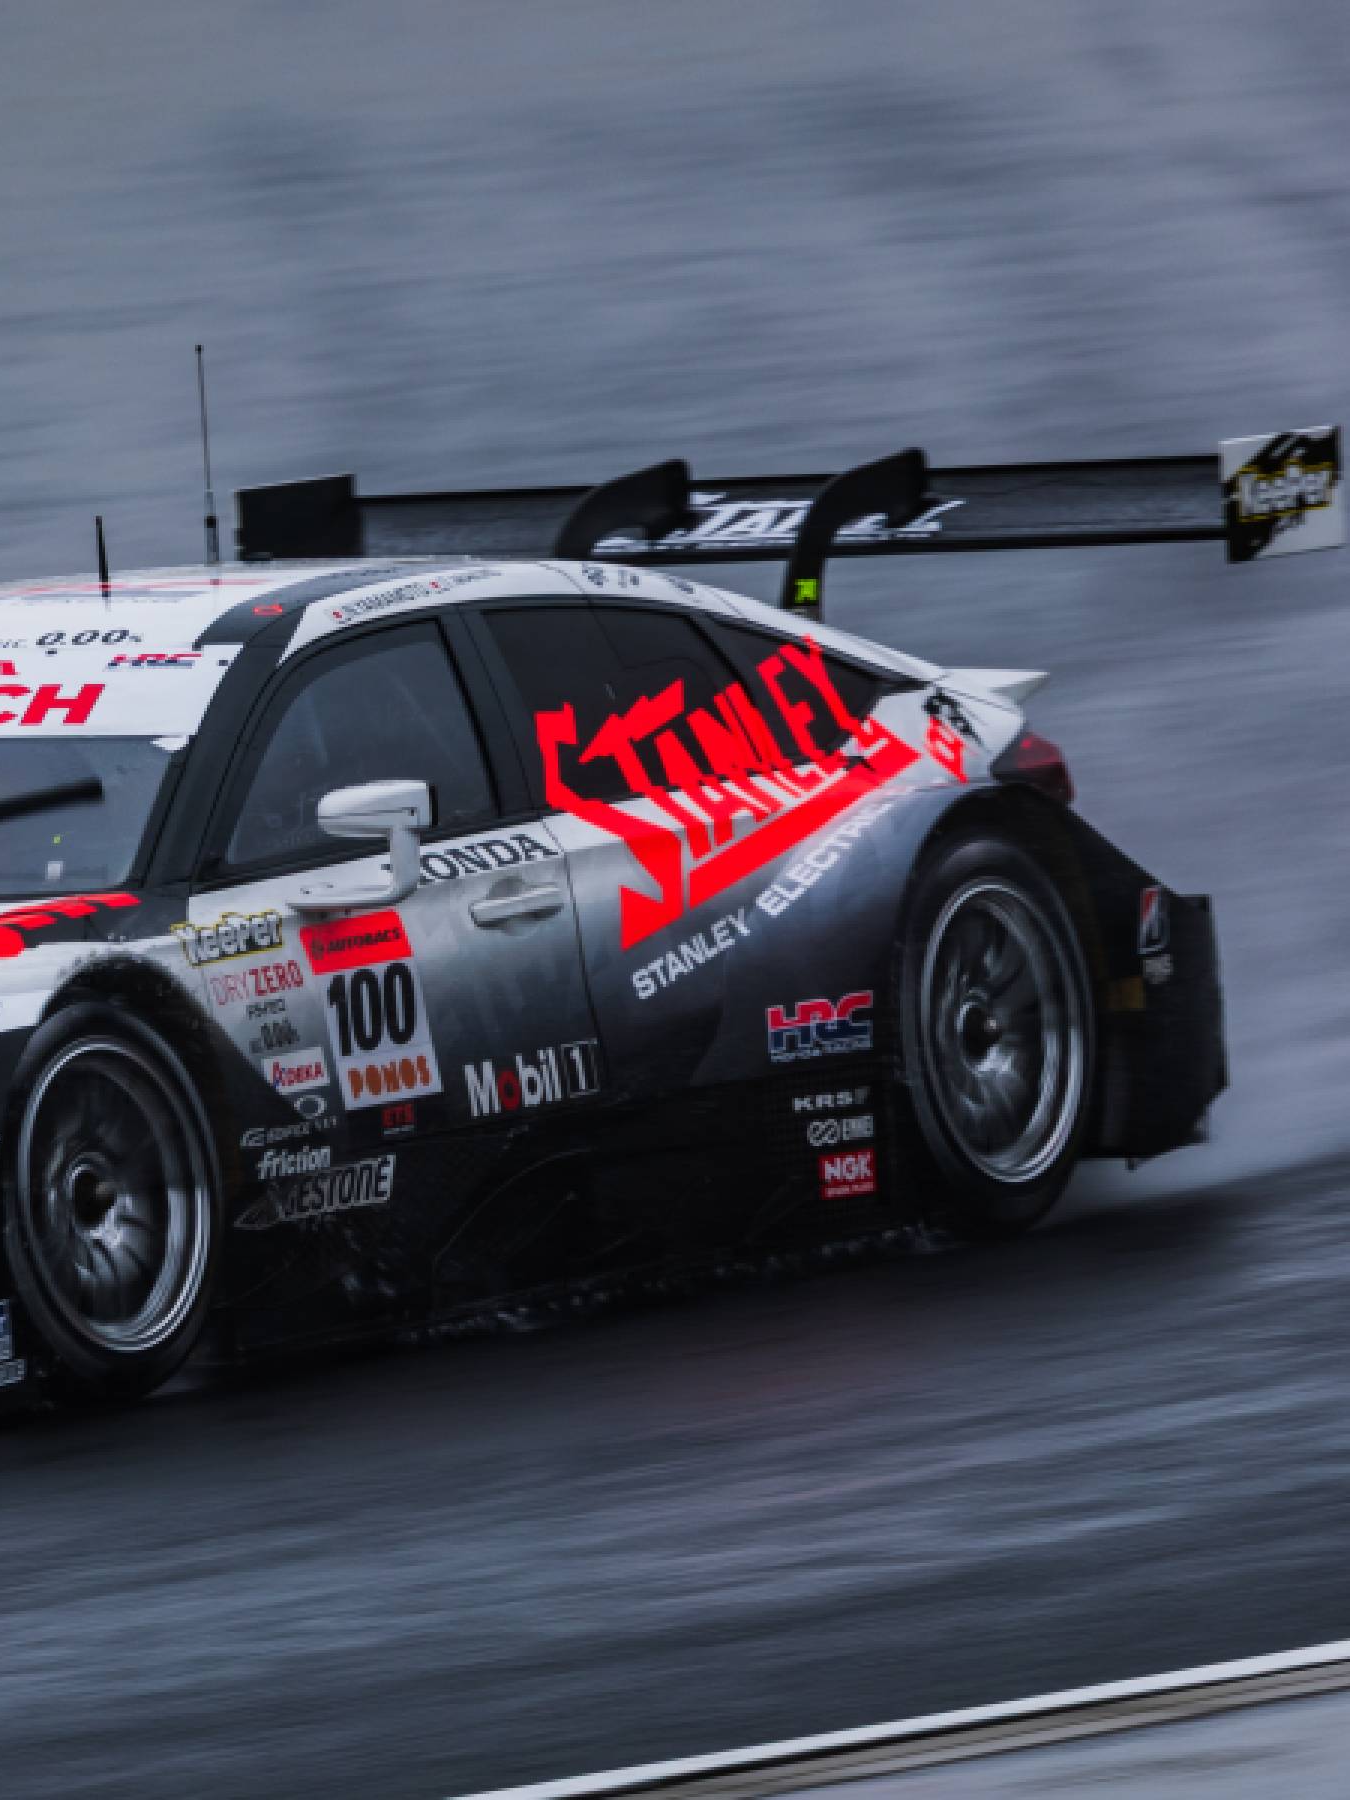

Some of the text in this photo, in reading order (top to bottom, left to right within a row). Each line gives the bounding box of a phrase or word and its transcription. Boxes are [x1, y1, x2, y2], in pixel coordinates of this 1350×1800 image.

[533, 634, 921, 953] STANLEY
[418, 834, 564, 886] ONDA
[631, 906, 751, 1000] STANLEY
[326, 962, 416, 1057] 100
[765, 990, 874, 1054] HRC
[348, 1055, 430, 1098] PONOS
[463, 1047, 561, 1117] Mobil
[823, 1152, 873, 1181] NGK
